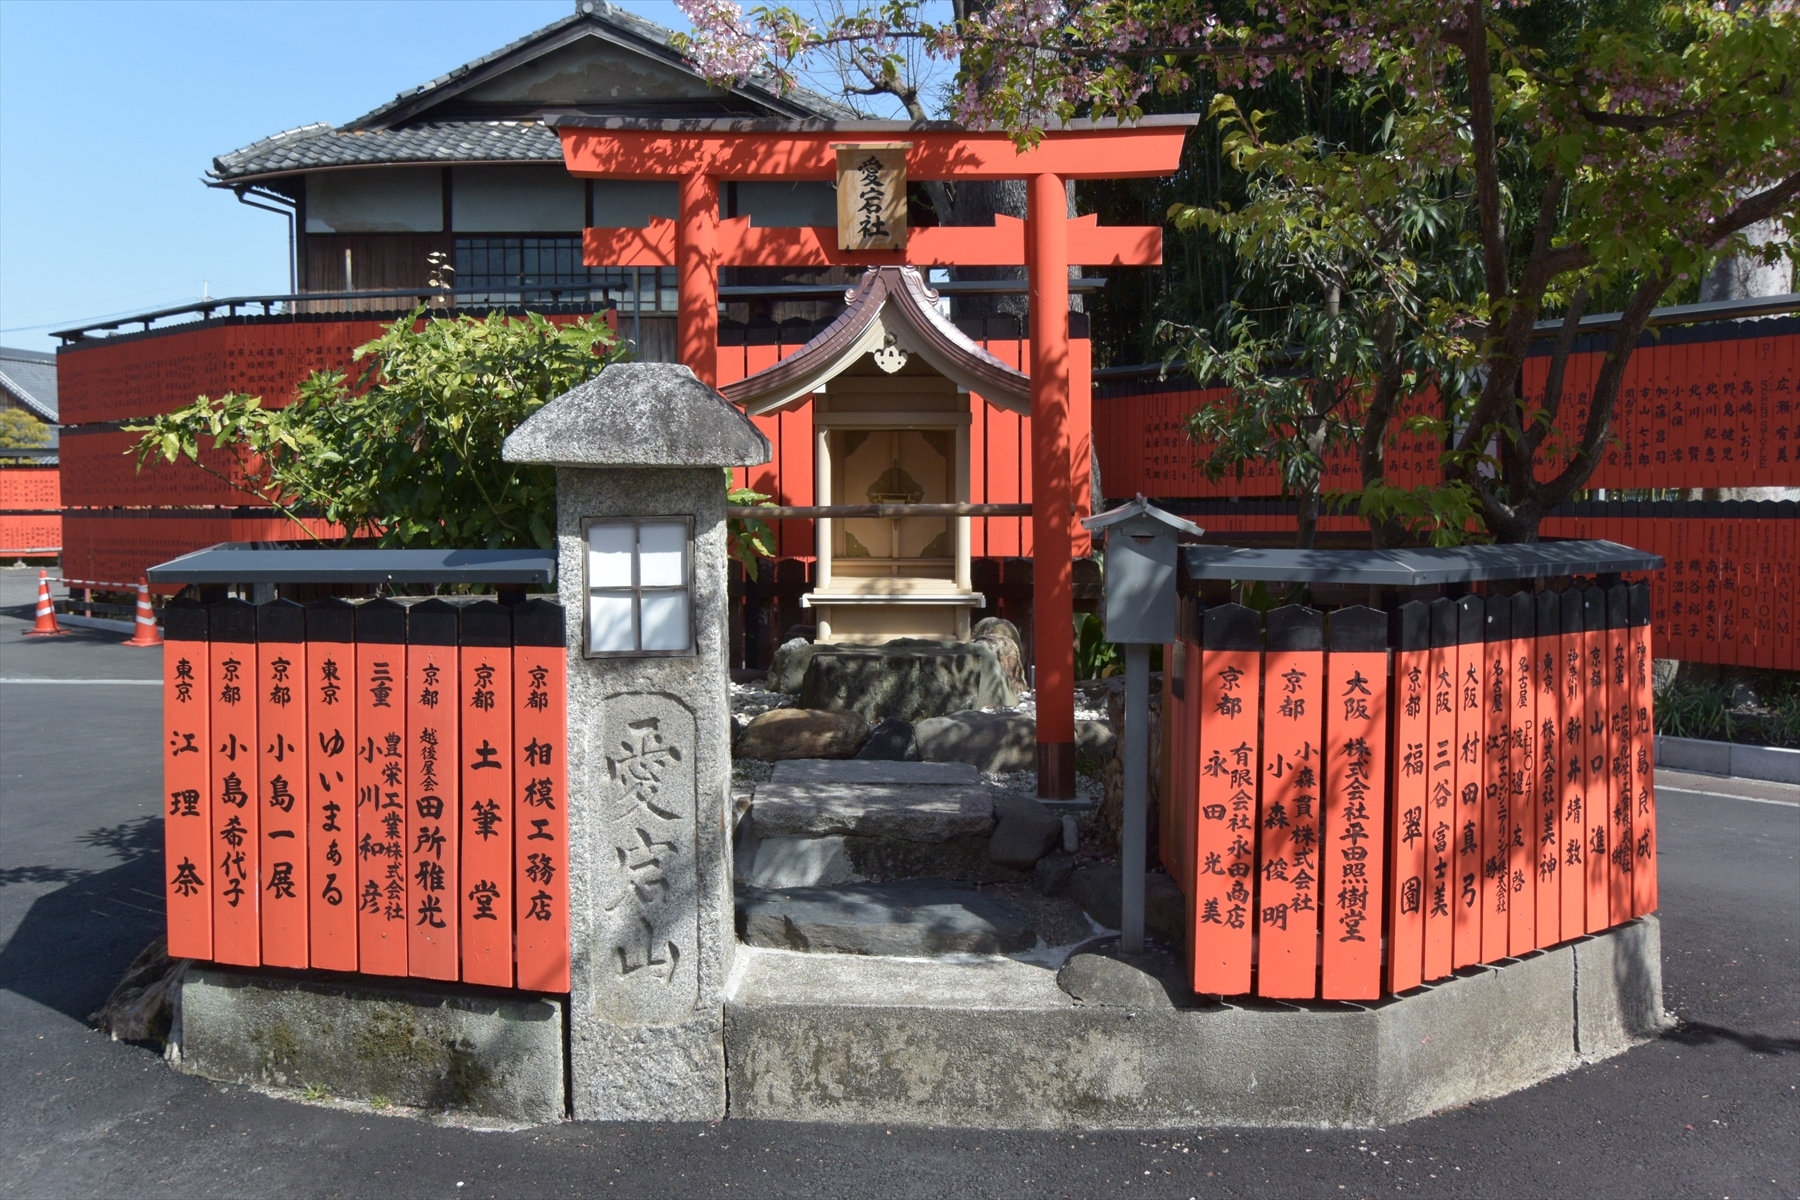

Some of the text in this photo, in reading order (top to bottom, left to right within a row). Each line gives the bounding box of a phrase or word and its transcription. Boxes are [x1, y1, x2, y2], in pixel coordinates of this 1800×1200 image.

[857, 154, 890, 239] 愛宕社
[320, 658, 341, 706] 東京
[369, 661, 394, 709] 三重
[417, 662, 441, 710] 京都
[1213, 665, 1245, 721] 京都
[1490, 659, 1504, 714] 名古屋
[1516, 656, 1530, 709] 名古屋
[1566, 648, 1579, 701] 神奈川
[1612, 642, 1625, 687] 兵庫
[1740, 562, 1752, 645] SORA
[1758, 562, 1771, 646] HITOMI
[1776, 561, 1792, 648] MANAMI
[169, 657, 204, 898] 東京 江理奈
[217, 656, 248, 908] 京都 小島希代子
[266, 656, 297, 900] 京都 小島一展
[1276, 667, 1308, 722] 京都
[1459, 661, 1481, 908] 大阪 村田真弓
[1539, 651, 1558, 885] 東京 株式会社美神
[1589, 646, 1606, 855] 京都 山口進
[1634, 642, 1652, 860] 神奈川 児島良成
[357, 736, 384, 916] 小川和彦
[381, 731, 406, 922] 豊栄工業株式会社
[468, 662, 503, 921] 京都 土筆堂
[523, 664, 557, 922] 京都 相模工務店
[604, 716, 684, 986] 愛宕山
[1200, 749, 1230, 926] 永田光美
[1222, 740, 1254, 930] 有限会社永田商店
[1260, 753, 1294, 932] 小森俊明
[1335, 669, 1372, 944] 大阪 株式会社平田照樹堂
[1399, 665, 1425, 916] 京都 福翠園
[1430, 665, 1452, 920] 大阪 三谷富士美
